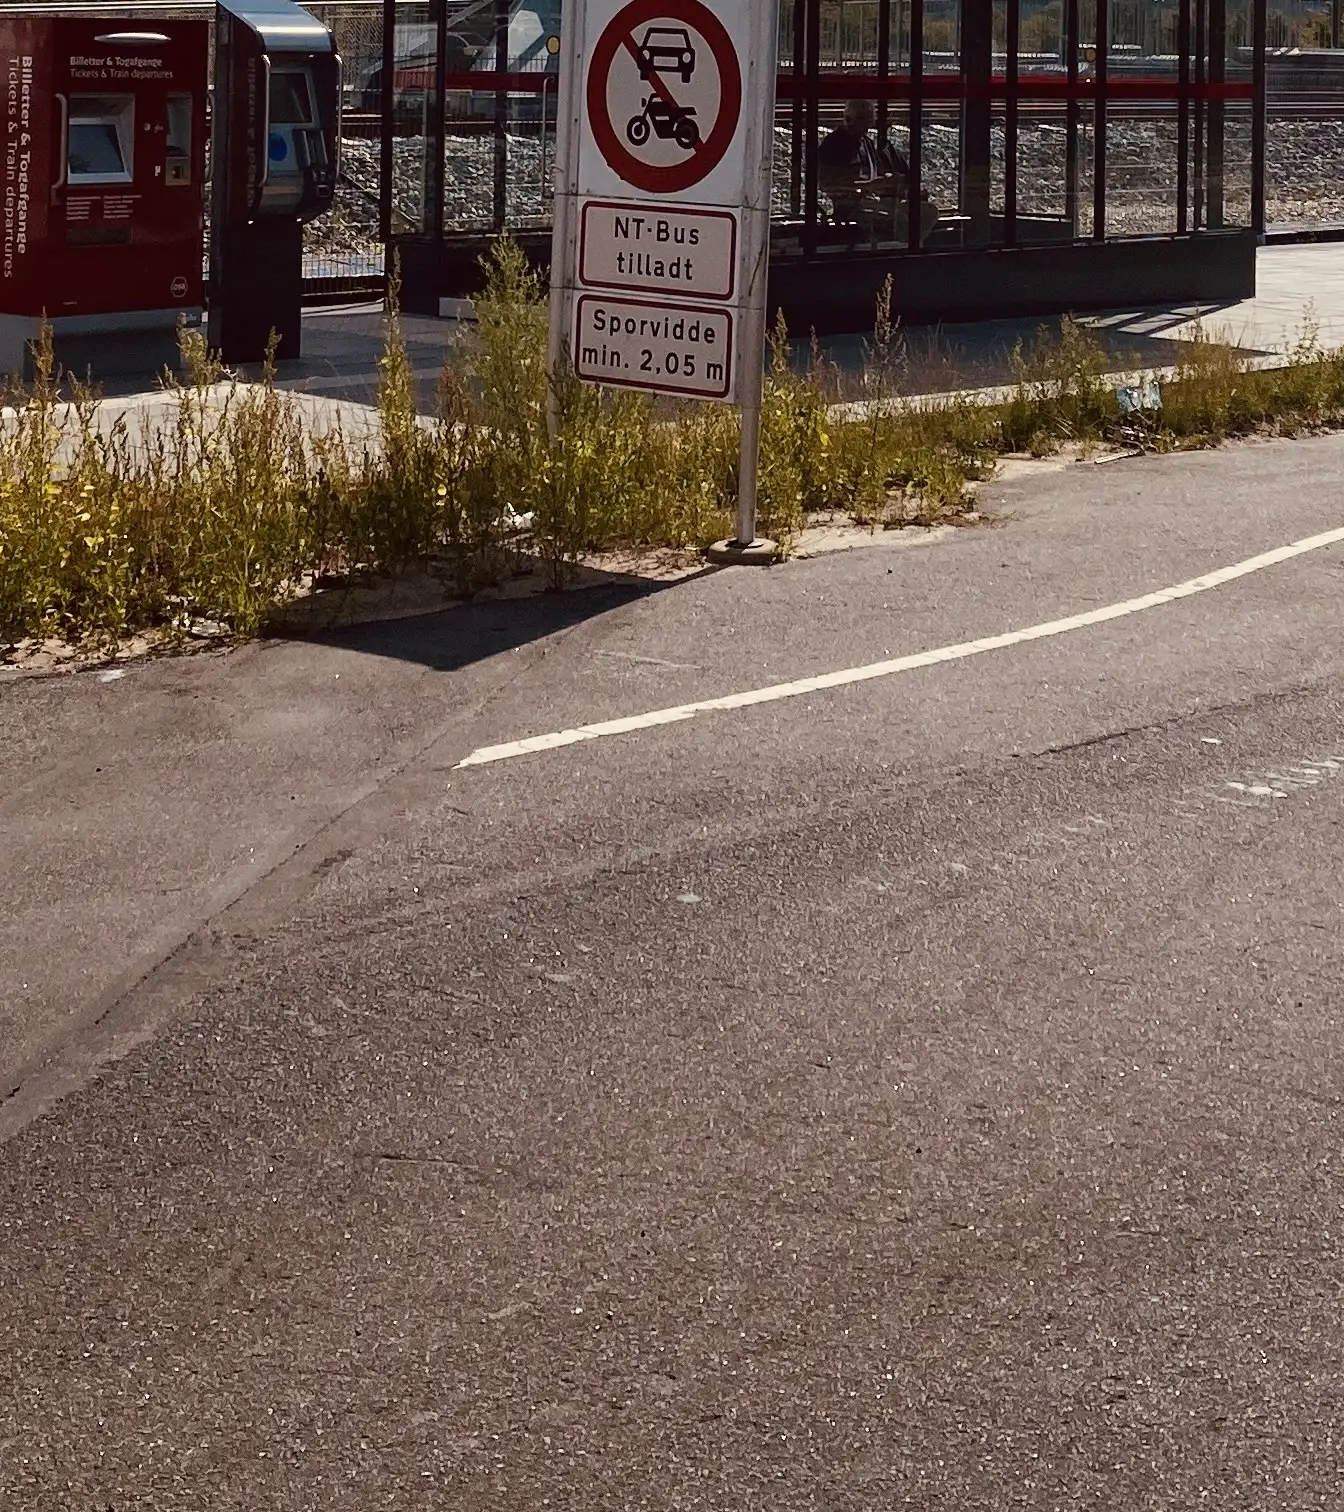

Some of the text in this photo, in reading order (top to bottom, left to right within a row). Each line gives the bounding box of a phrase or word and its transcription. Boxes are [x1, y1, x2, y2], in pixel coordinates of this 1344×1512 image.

[69, 56, 163, 68] Billetter & Togafgange
[69, 68, 174, 80] Tickets & Train departures
[3, 55, 20, 279] Tickets & Train departures
[16, 55, 33, 255] Billetter & Togafgange
[613, 215, 701, 246] NT-Bus
[616, 250, 694, 281] tilladt
[592, 308, 717, 345] Sporvidde
[581, 345, 724, 382] min. 2,05 m
